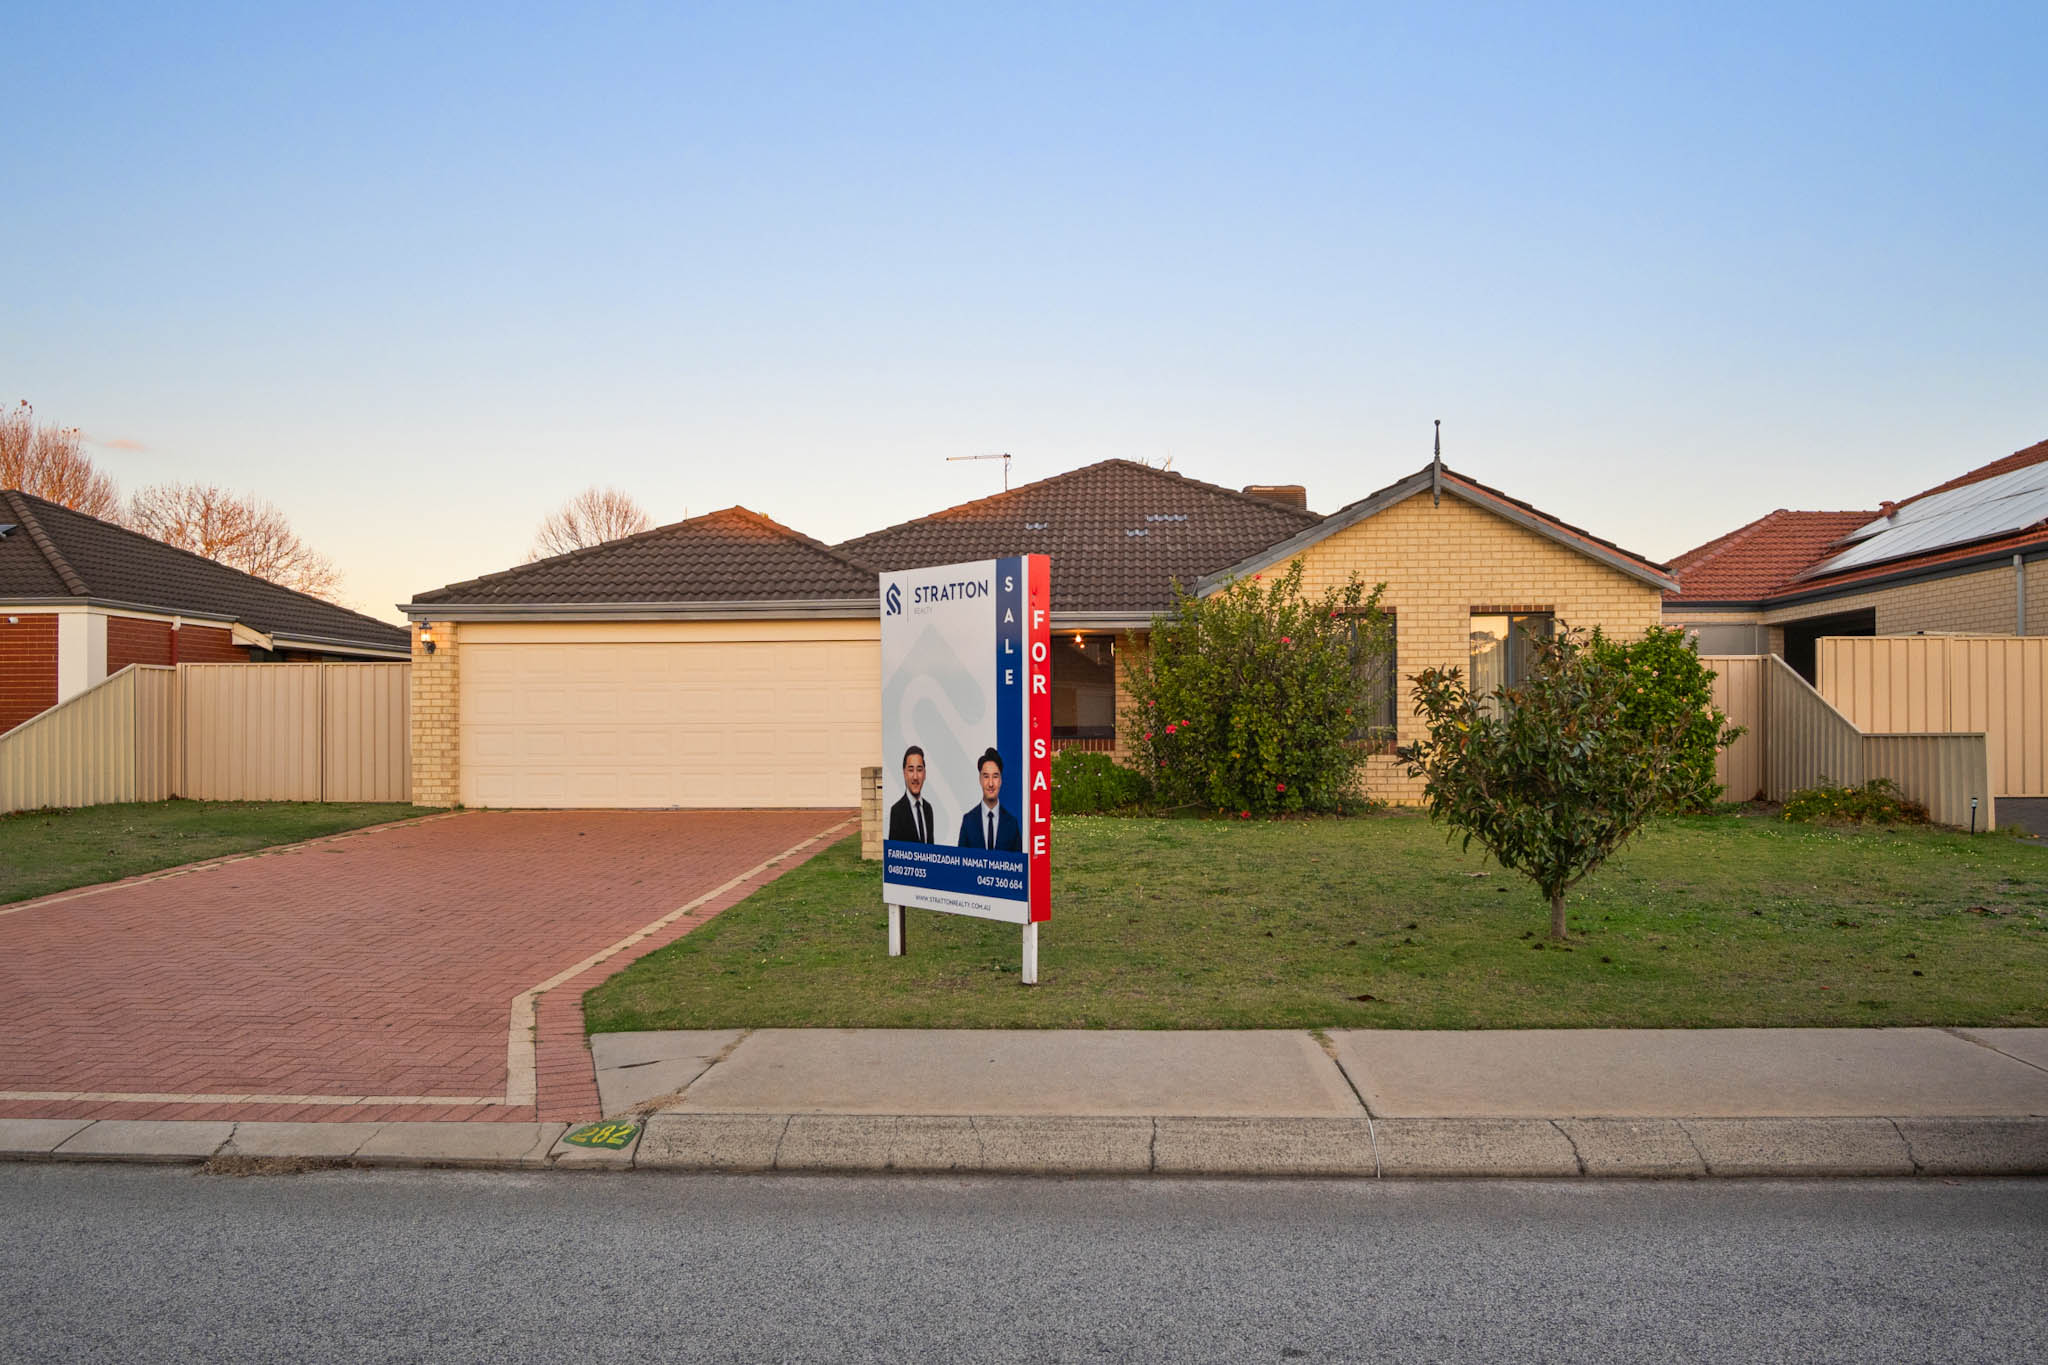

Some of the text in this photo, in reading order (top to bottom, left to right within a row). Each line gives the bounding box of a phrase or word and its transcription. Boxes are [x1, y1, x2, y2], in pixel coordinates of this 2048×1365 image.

[914, 579, 988, 603] STRATTON
[914, 606, 932, 615] REALTY
[1004, 576, 1014, 685] SALE
[1031, 609, 1047, 855] FOR SALE
[888, 848, 913, 861] FARHAD
[888, 864, 927, 878] 0480 277 033
[962, 857, 1023, 873] NAMAT MAHRAMI
[977, 875, 1023, 890] 0457 360 684
